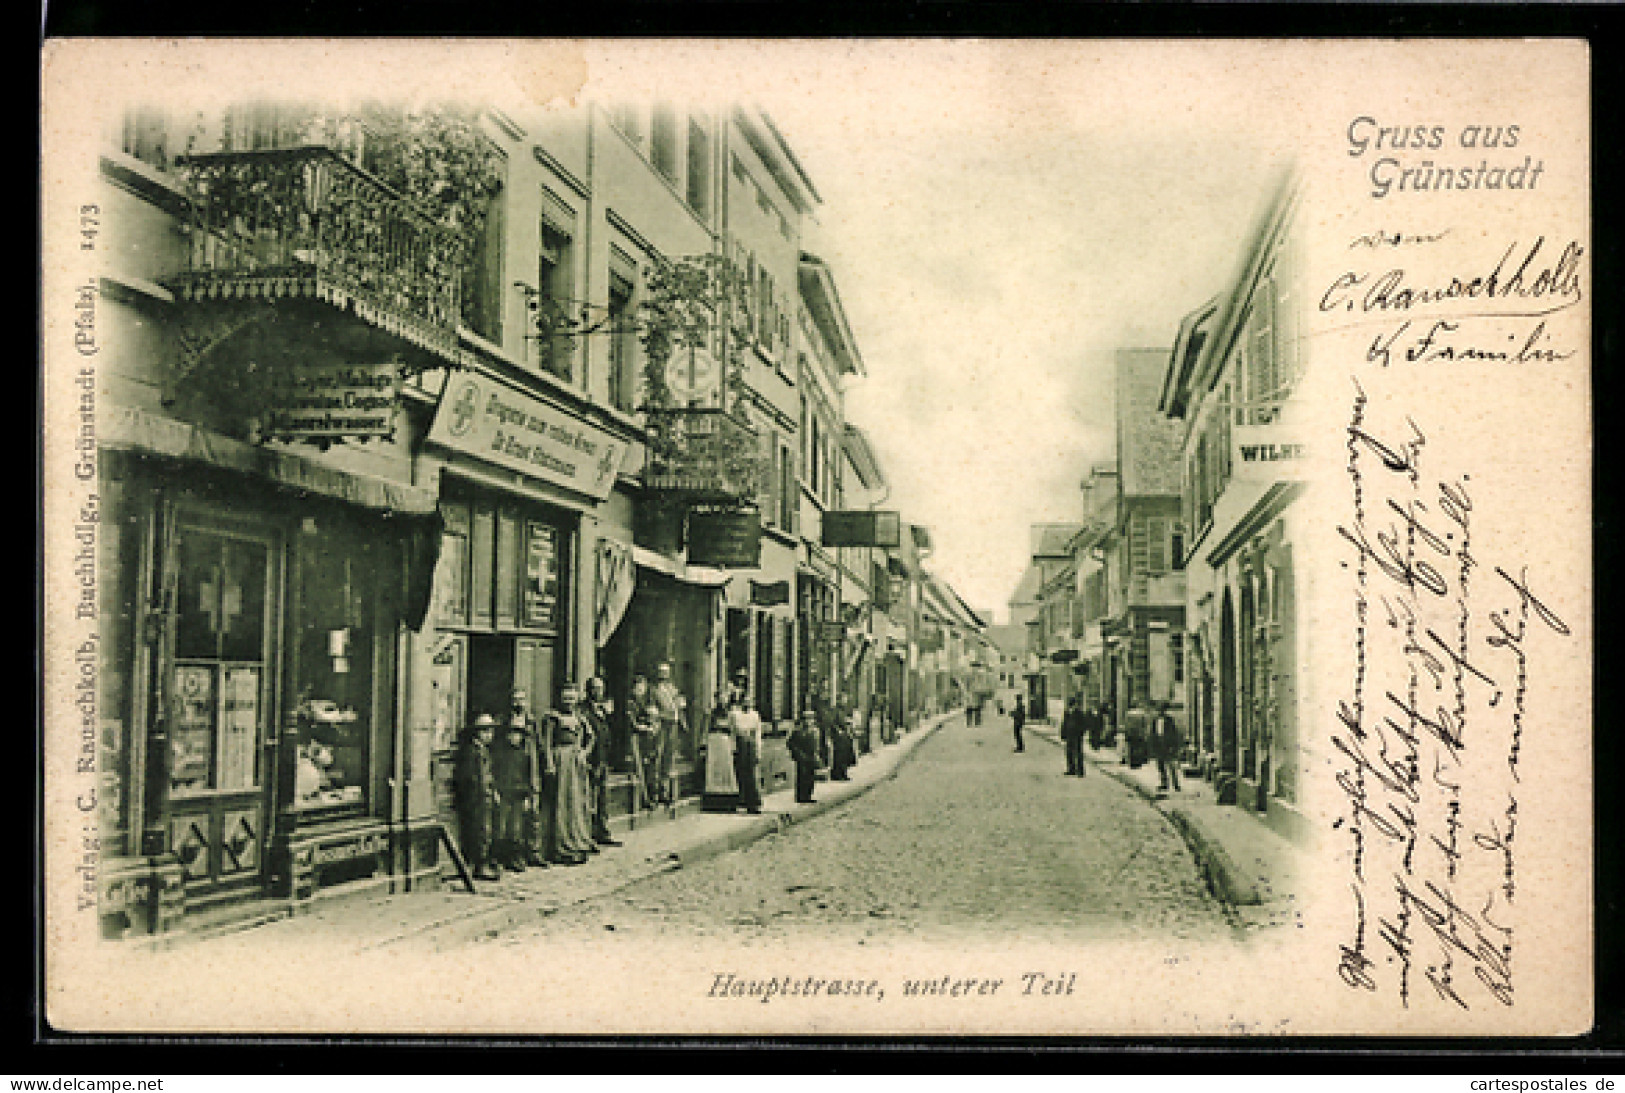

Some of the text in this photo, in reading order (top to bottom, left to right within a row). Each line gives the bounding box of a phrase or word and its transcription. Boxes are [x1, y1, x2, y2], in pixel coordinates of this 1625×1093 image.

[1347, 116, 1521, 157] Gruss aus
[1370, 156, 1545, 198] Grünstadt
[80, 204, 99, 250] 1473
[76, 369, 97, 481] Grünstadt
[76, 633, 98, 773] Rauschkolb,
[77, 789, 97, 812] C.
[77, 828, 99, 913] Verlag:
[708, 972, 1076, 1004] Hauptstrasse, unterer Teil
